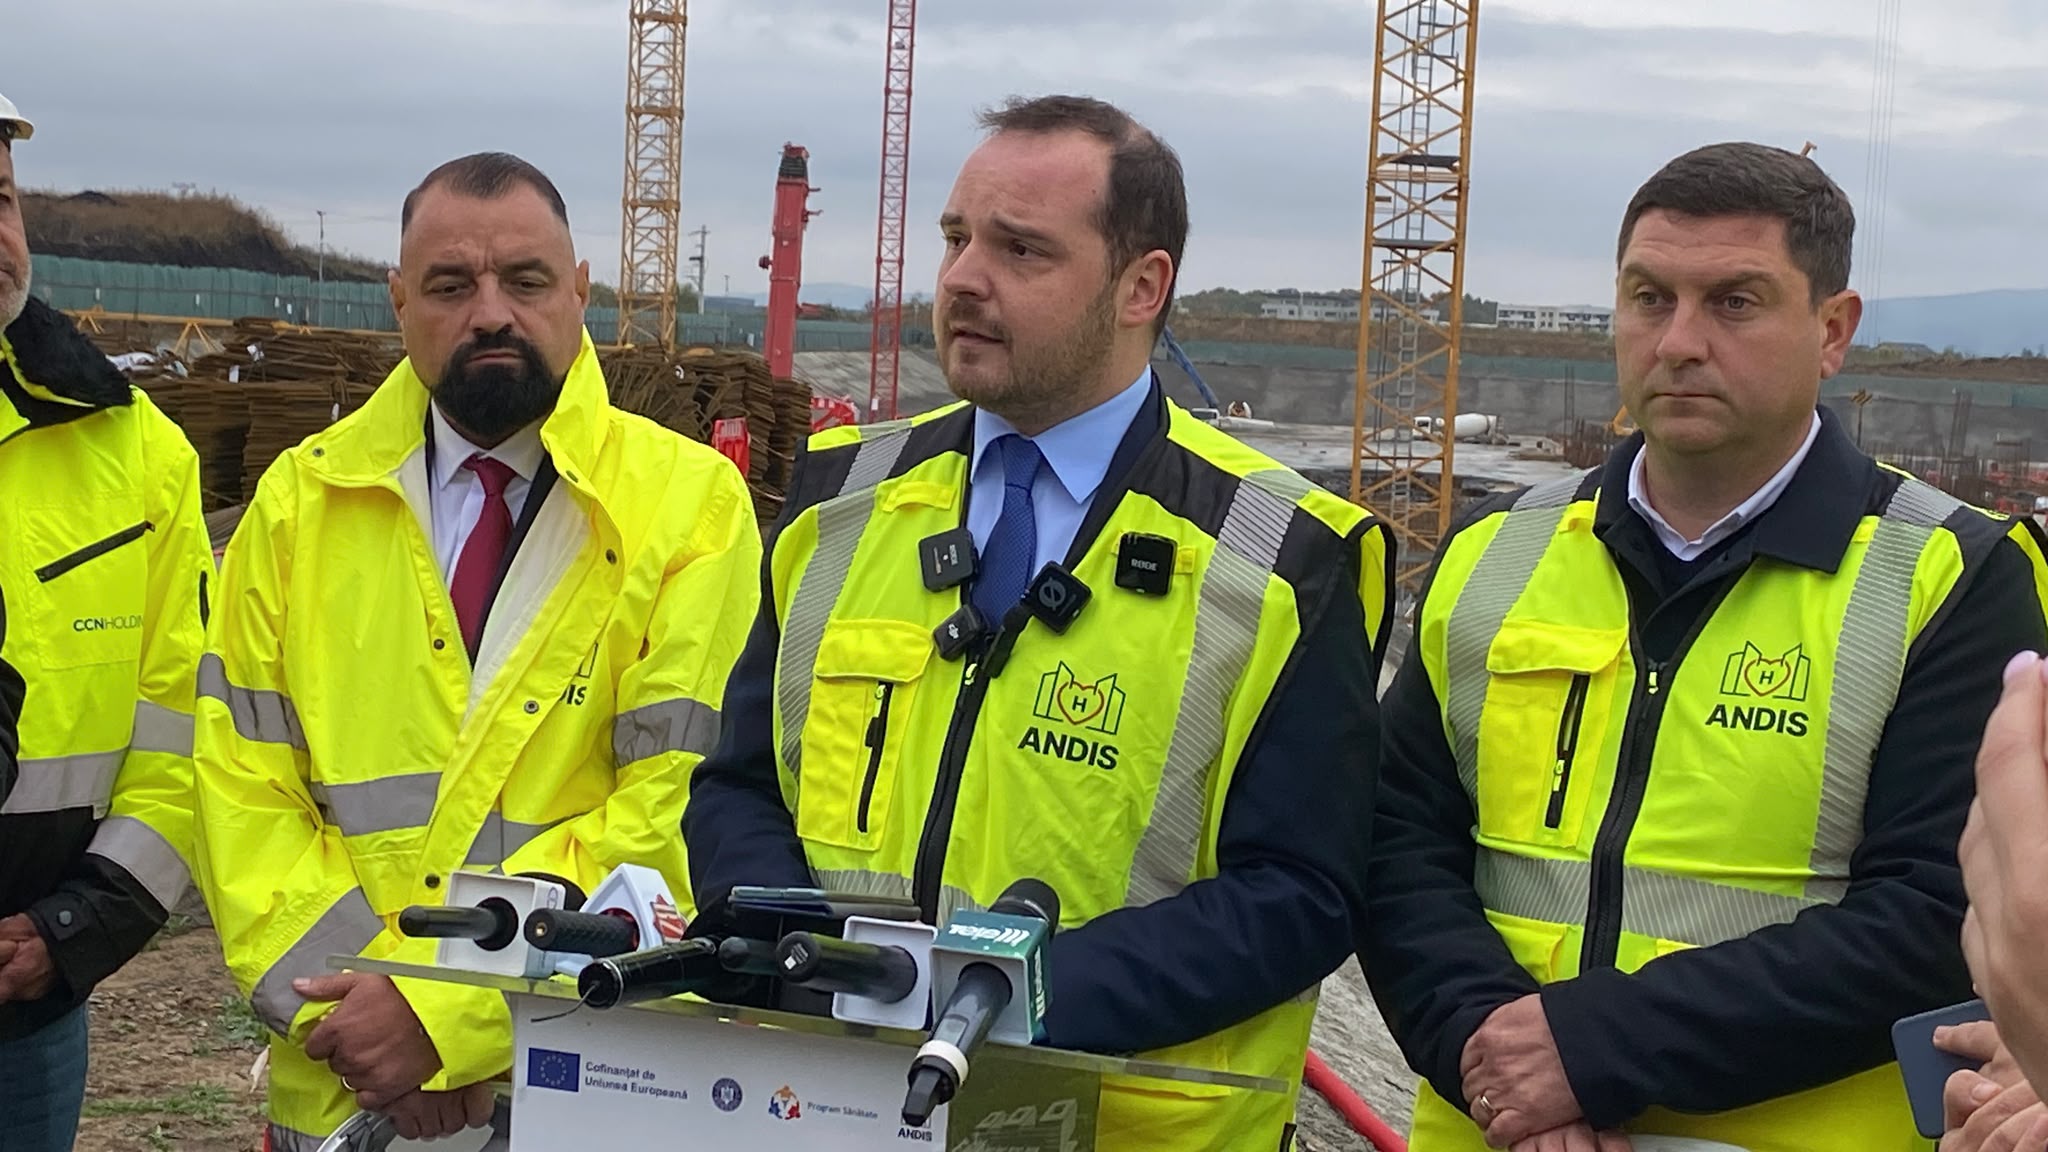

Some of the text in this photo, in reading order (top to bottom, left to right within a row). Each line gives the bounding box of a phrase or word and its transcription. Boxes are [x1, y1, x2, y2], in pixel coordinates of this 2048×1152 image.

[1759, 670, 1775, 685] H
[560, 685, 587, 706] IS
[1072, 695, 1087, 713] H
[1705, 703, 1809, 738] ANDIS
[1018, 726, 1119, 770] ANDIS
[642, 1069, 656, 1081] de
[898, 1127, 933, 1142] ANDIS
